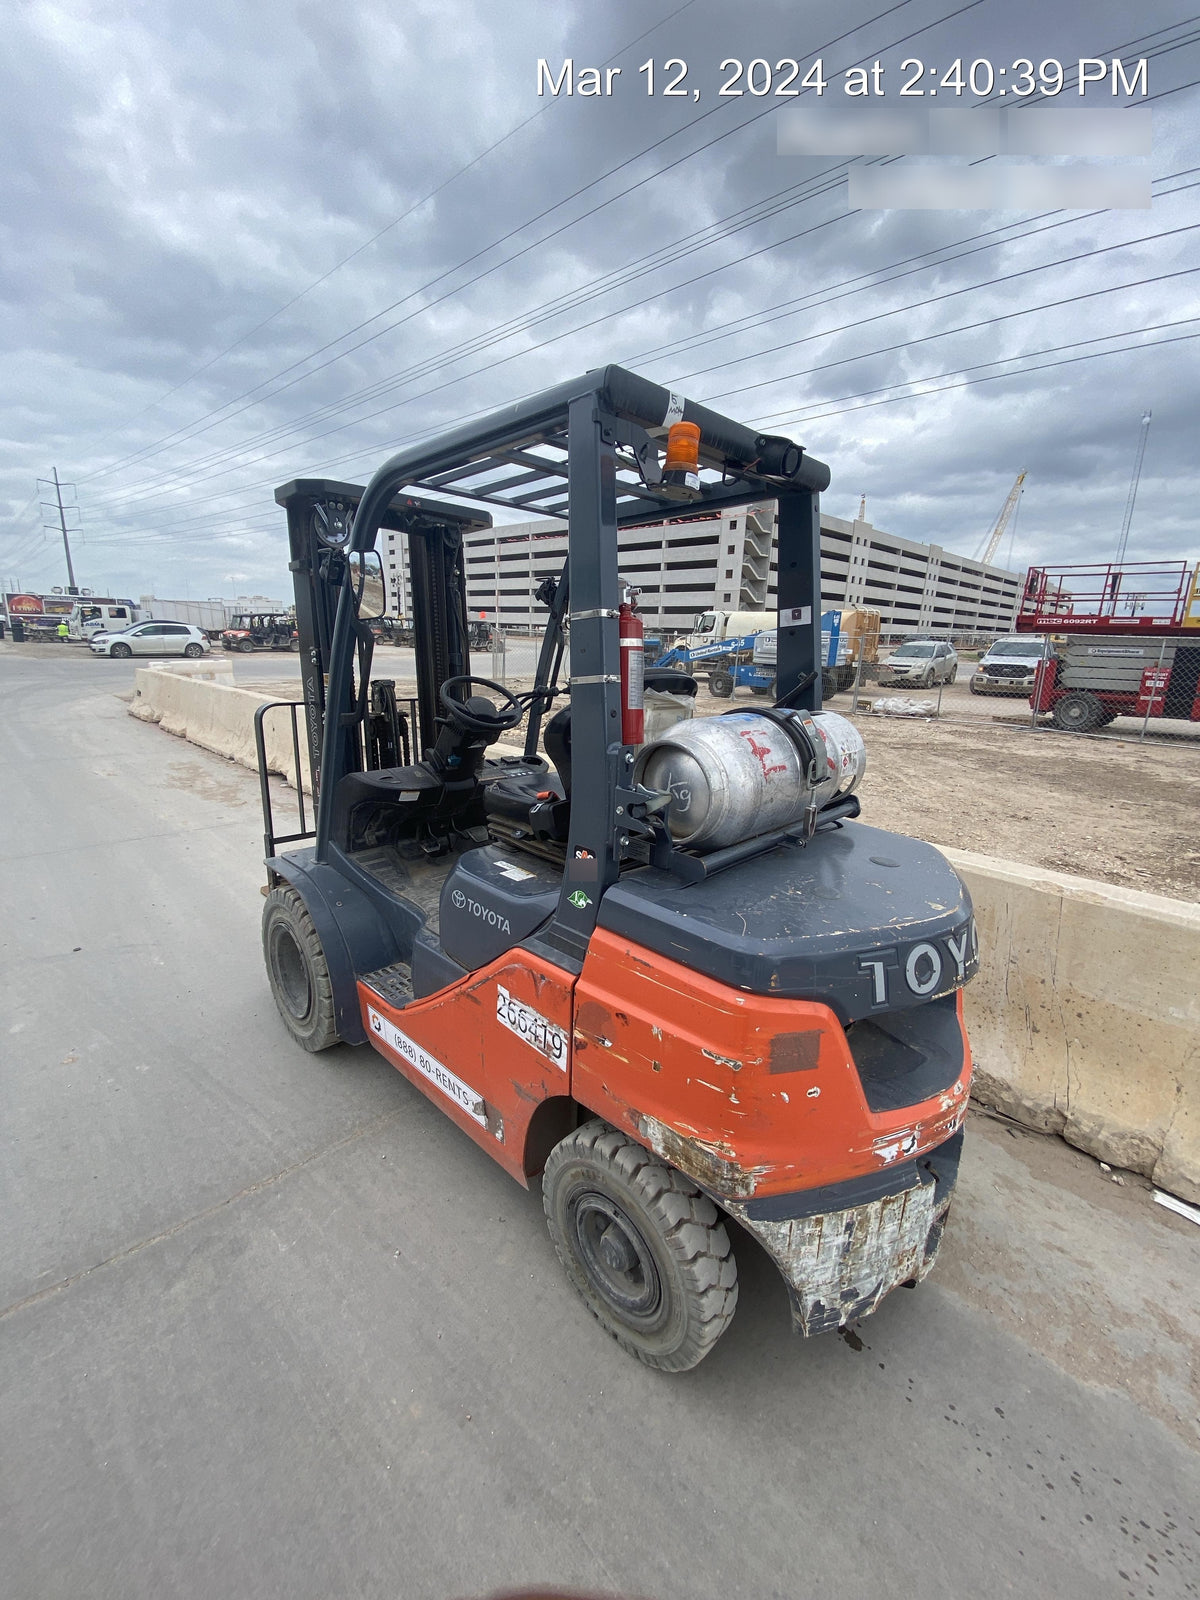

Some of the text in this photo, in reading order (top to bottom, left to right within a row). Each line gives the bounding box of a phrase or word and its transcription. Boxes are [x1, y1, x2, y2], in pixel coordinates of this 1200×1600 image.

[306, 676, 320, 759] TOYOTA
[467, 898, 511, 935] TOYOTA
[497, 994, 563, 1059] 266419
[394, 1032, 470, 1106] (888) 80-RENTS
